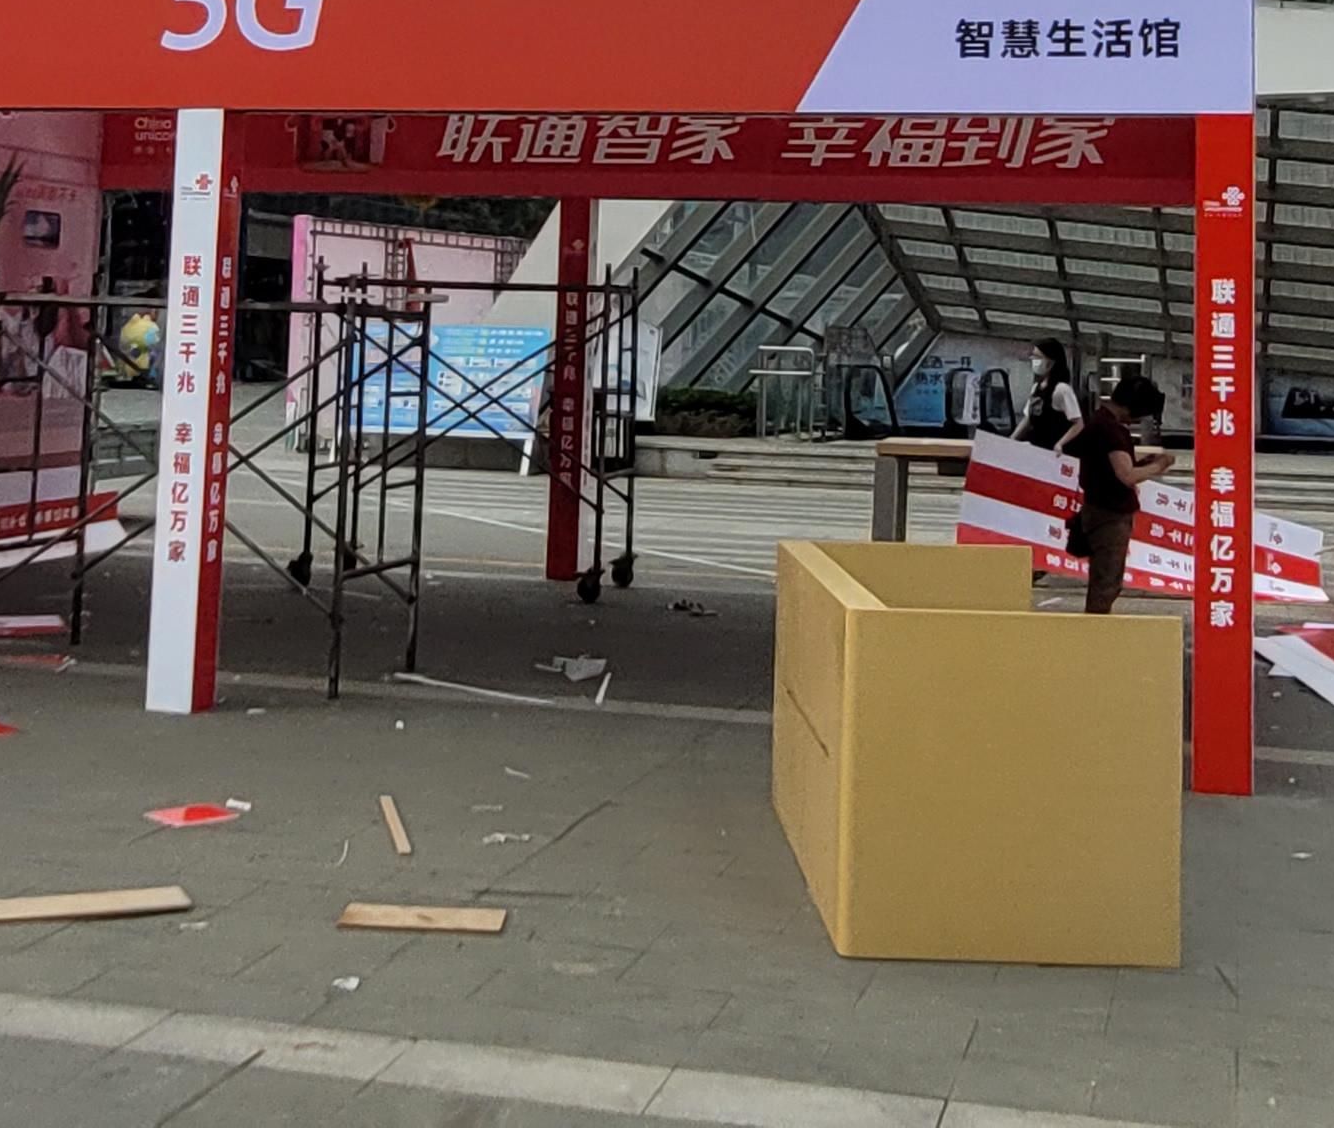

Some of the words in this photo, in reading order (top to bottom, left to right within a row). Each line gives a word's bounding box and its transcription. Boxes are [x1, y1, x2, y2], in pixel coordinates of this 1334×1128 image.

[954, 18, 1181, 59] 智慧生活馆
[436, 113, 749, 164] 联通智家
[780, 115, 1116, 169] 幸福到家
[177, 255, 202, 394] 联通三千兆
[1210, 278, 1236, 437] 联通三千兆
[167, 423, 193, 563] 幸福亿万家
[1210, 467, 1236, 628] 幸福亿万家
